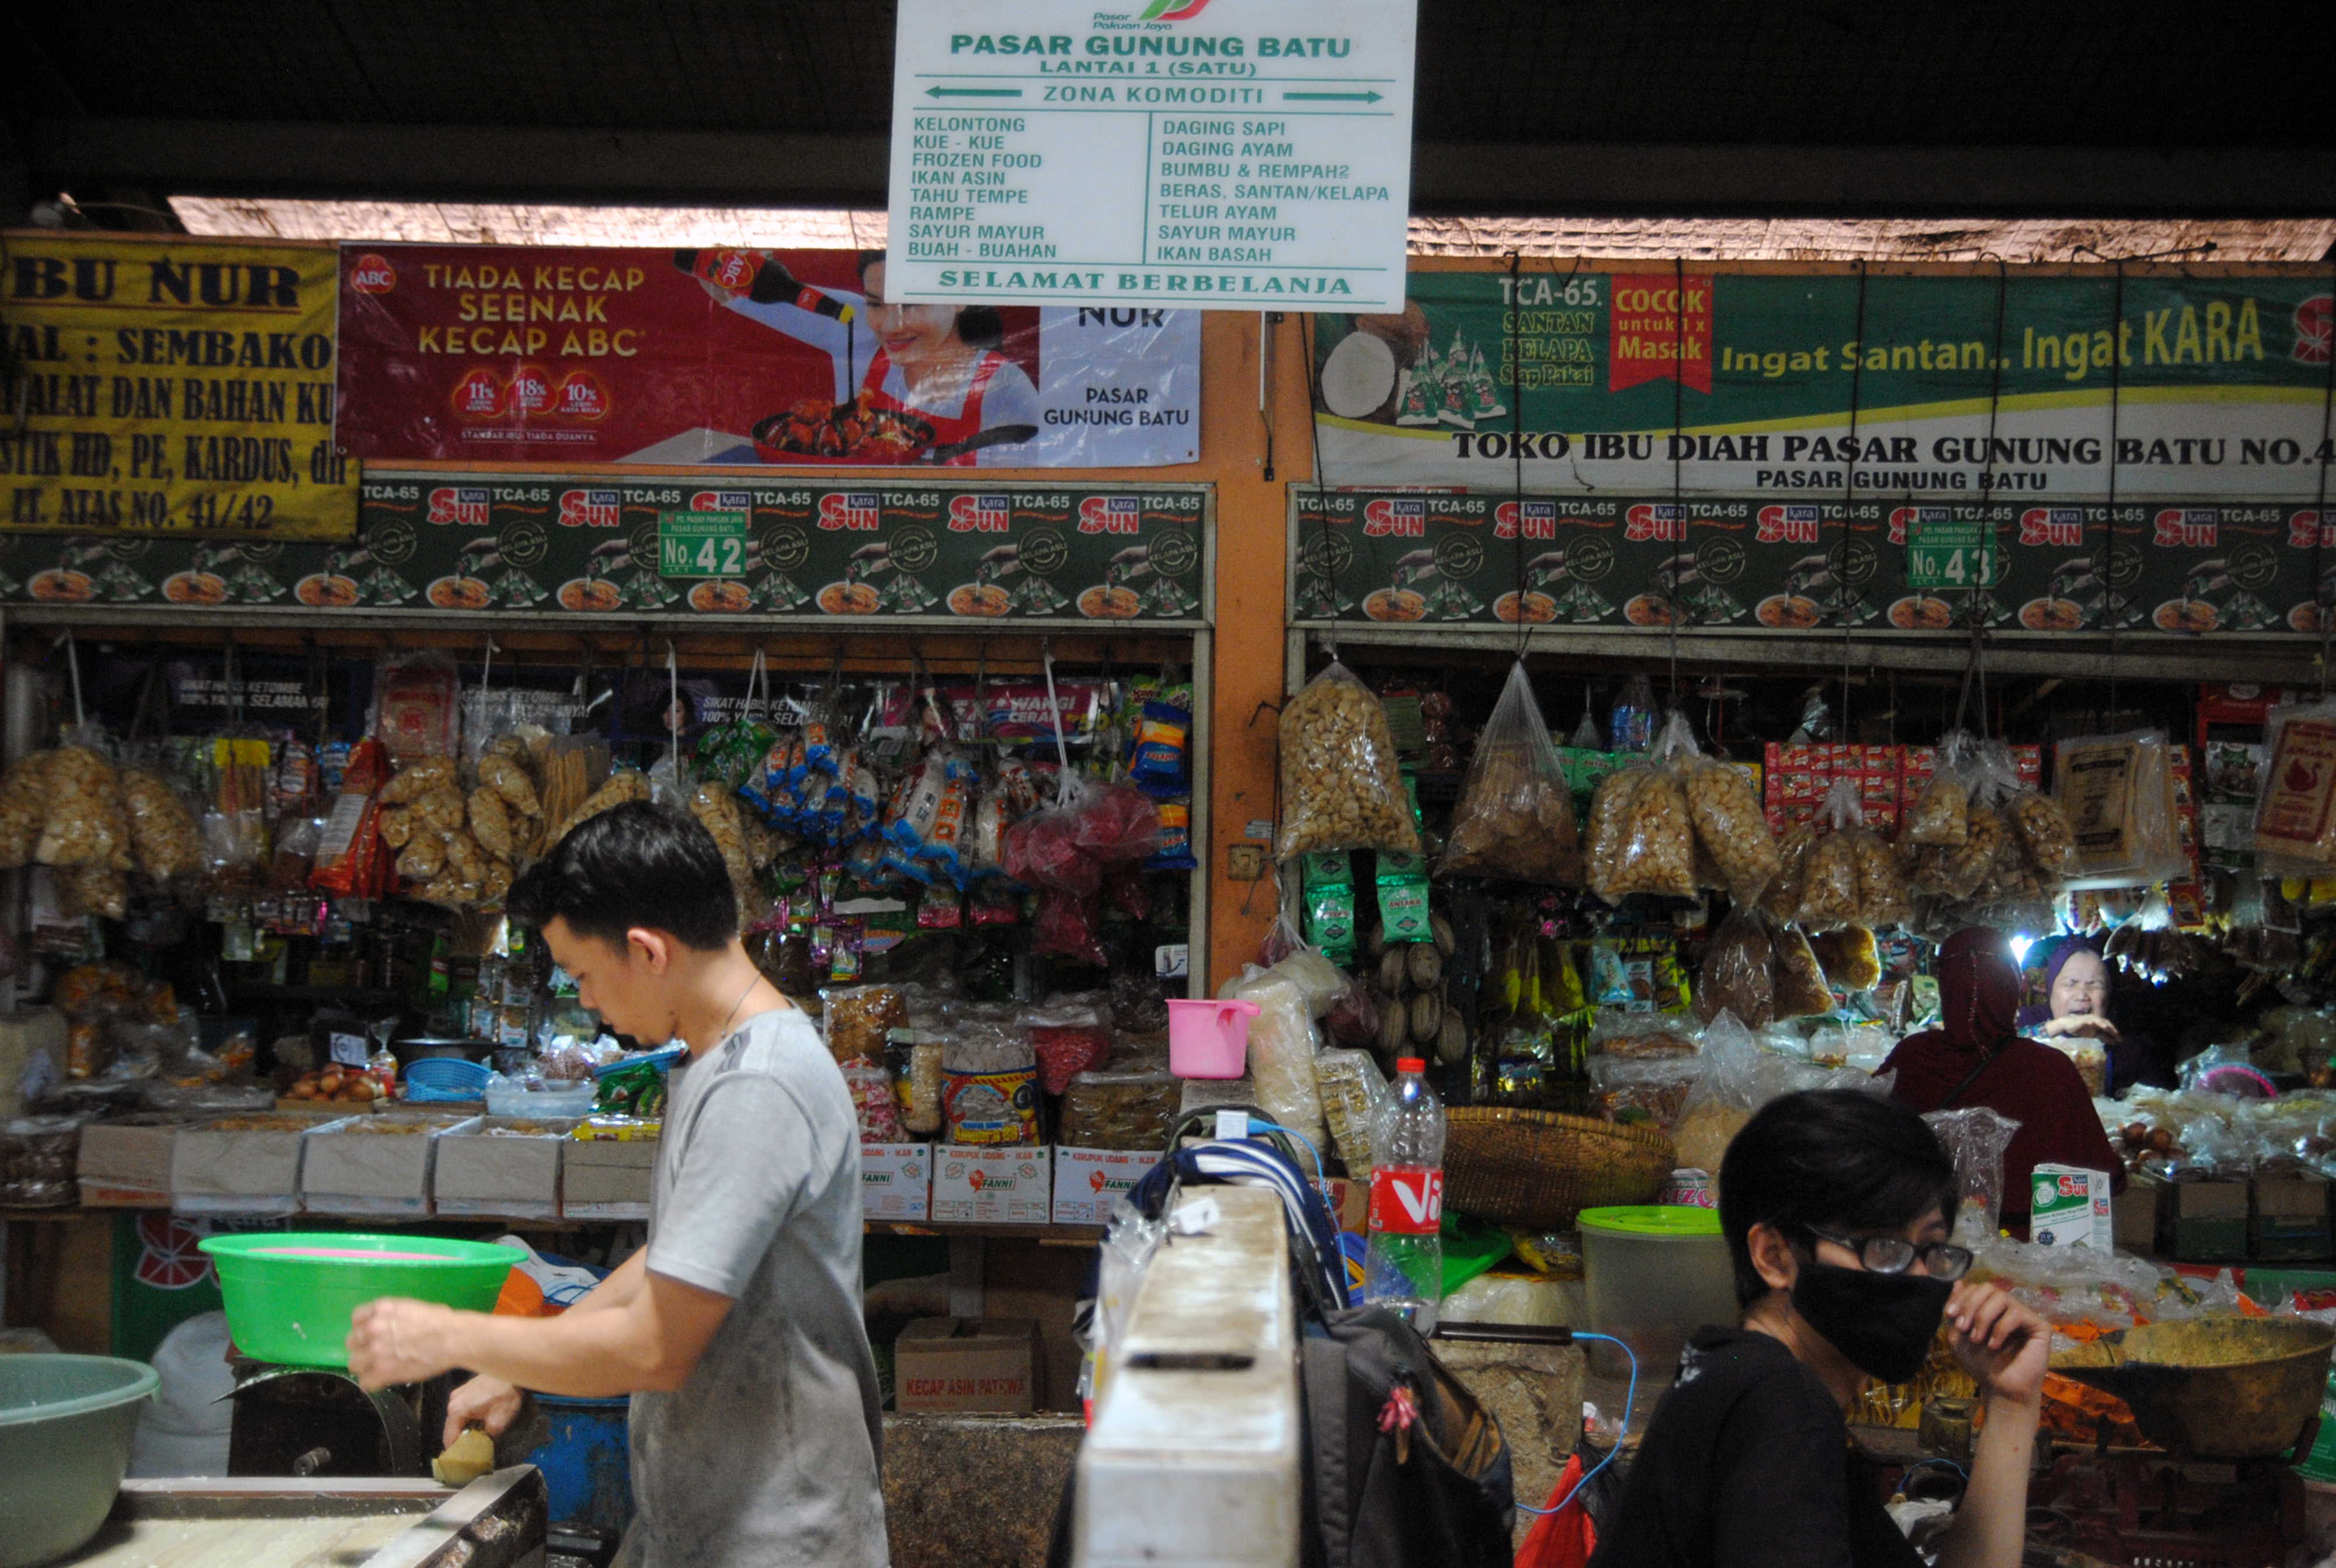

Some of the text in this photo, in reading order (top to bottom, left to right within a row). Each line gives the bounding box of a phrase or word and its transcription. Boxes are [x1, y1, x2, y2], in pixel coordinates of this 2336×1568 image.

[1093, 22, 1172, 32] Pakuan Jaya
[950, 35, 1351, 58] PASAR GUNUNG BATU
[1040, 61, 1257, 78] LANTAI 1 (SATU)
[1043, 86, 1263, 104] ZONA KOMODITI
[913, 117, 1026, 133] KELONTONG
[1163, 120, 1286, 137] DAGING SAPI
[913, 135, 949, 150] KUE
[968, 135, 1004, 150] KUE
[1162, 141, 1293, 157] DAGING AYAM
[912, 153, 1042, 168] FROZEN FOOD
[911, 171, 1006, 186] IKAN ASIN
[1161, 162, 1350, 179] BUMBU & REMPAH2
[910, 188, 1028, 204] TAHU TEMPE
[1160, 183, 1389, 201] BERAS, SANTAN/KELAPA
[909, 206, 975, 221] RAMPE
[1159, 204, 1277, 220] TELUR AYAM
[908, 224, 1045, 240] SAYUR MAYUR
[1158, 225, 1296, 242] SAYUR MAYUR
[908, 242, 960, 257] BUAH
[979, 243, 1057, 258] BUAHAN
[1157, 246, 1272, 262] IKAN BASAH
[13, 256, 301, 308] BU NUR
[355, 270, 391, 287] ABC
[423, 264, 644, 292] TIADA KECAP
[938, 270, 1353, 294] SELAMAT BERBELANJA
[458, 293, 608, 323] SEENAK
[1615, 288, 1705, 314] COCOK
[1077, 306, 1166, 330] NUR
[1502, 311, 1595, 334] SANTAN
[1618, 317, 1675, 332] untuk
[418, 325, 639, 357] KECAP ABC
[1617, 335, 1703, 359] Masak
[1722, 345, 1829, 377] Ingat
[2023, 322, 2132, 381] Ingat
[2144, 297, 2265, 366] KARA
[117, 328, 333, 370] SEMBAKO
[1502, 338, 1595, 363] KELAPA
[1499, 364, 1594, 390] Siap Pakai
[469, 379, 597, 401] 11% 18% 10%
[1086, 388, 1149, 405] PASAR
[111, 376, 173, 419] DAN
[182, 378, 287, 424] BAHAN
[1044, 409, 1190, 426] GUNUNG BATU
[1451, 432, 1570, 460] TOKO
[1583, 433, 1653, 460] IBU
[1666, 434, 1770, 461] DIAH
[1782, 435, 1919, 464] PASAR
[1932, 437, 2101, 465] GUNUNG
[2115, 438, 2224, 465] BATU
[1756, 470, 2048, 491] PASAR GUNUNG BATU
[362, 486, 420, 500] TCA-65
[460, 490, 486, 503] kara
[493, 488, 551, 502] TCA-65
[591, 492, 616, 505] kara
[624, 489, 681, 504] TCA-65
[754, 492, 812, 506] TCA-65
[850, 495, 875, 508] kara
[882, 492, 940, 507] TCA-65
[1013, 494, 1070, 509] TCA-65
[186, 493, 274, 531] 41/42
[427, 488, 489, 525] SUN
[558, 490, 620, 527] SUN
[818, 492, 879, 531] SUN
[981, 497, 1005, 510] kara
[1110, 498, 1135, 511] kara
[1142, 496, 1201, 511] TCA-65
[1396, 501, 1420, 514] kara
[1428, 500, 1486, 514] TCA-65
[1527, 504, 1552, 517] kara
[1559, 502, 1617, 516] TCA-65
[1690, 504, 1748, 517] TCA-65
[948, 493, 1010, 534] SUN
[1077, 496, 1139, 534] SUN
[1362, 499, 1425, 537] SUN
[1493, 501, 1555, 539] SUN
[1789, 507, 1814, 520] kara
[1756, 505, 1818, 543] SUN
[2018, 507, 2083, 547] SUN
[2152, 508, 2217, 547] SUN
[665, 537, 742, 573] No. 42
[1912, 548, 1991, 585] No. 43
[982, 1178, 1014, 1189] FANNI
[1104, 1180, 1134, 1190] FANNI
[2057, 1175, 2088, 1197] SUN
[906, 1379, 945, 1396] KECAP
[947, 1379, 975, 1396] ASIN
